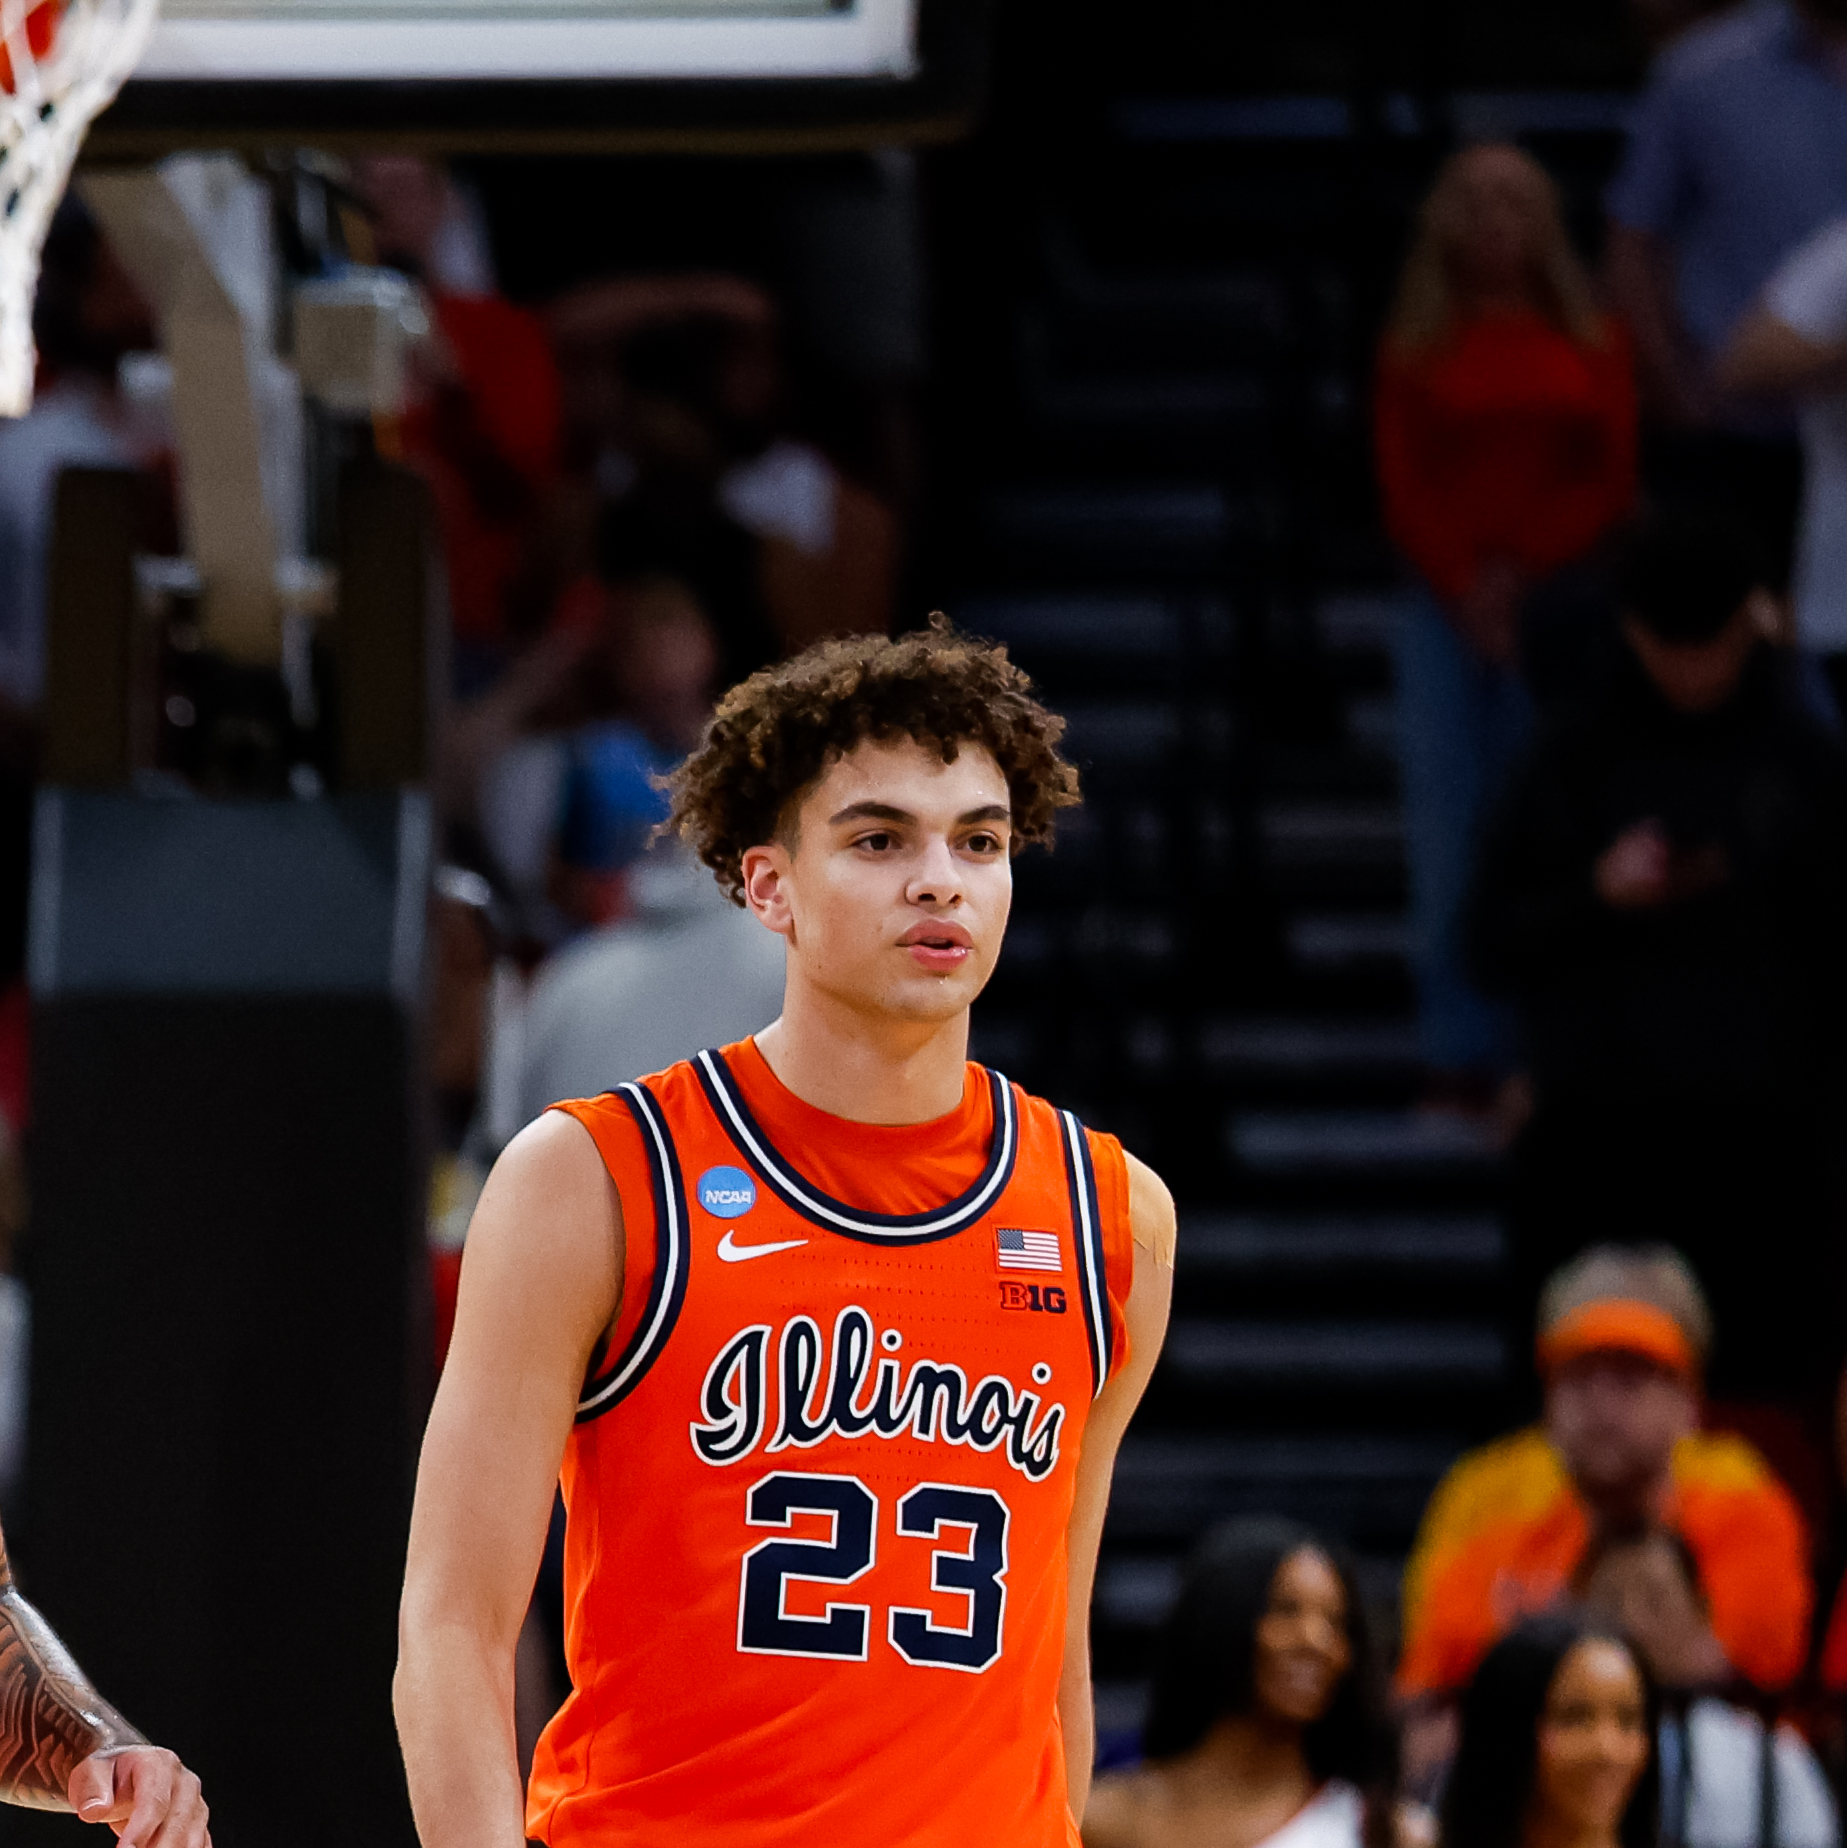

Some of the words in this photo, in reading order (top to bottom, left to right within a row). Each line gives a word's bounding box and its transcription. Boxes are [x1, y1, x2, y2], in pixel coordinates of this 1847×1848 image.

[705, 1188, 752, 1206] NCAA
[689, 1305, 1065, 1482] Illinois
[737, 1471, 1010, 1673] 23
